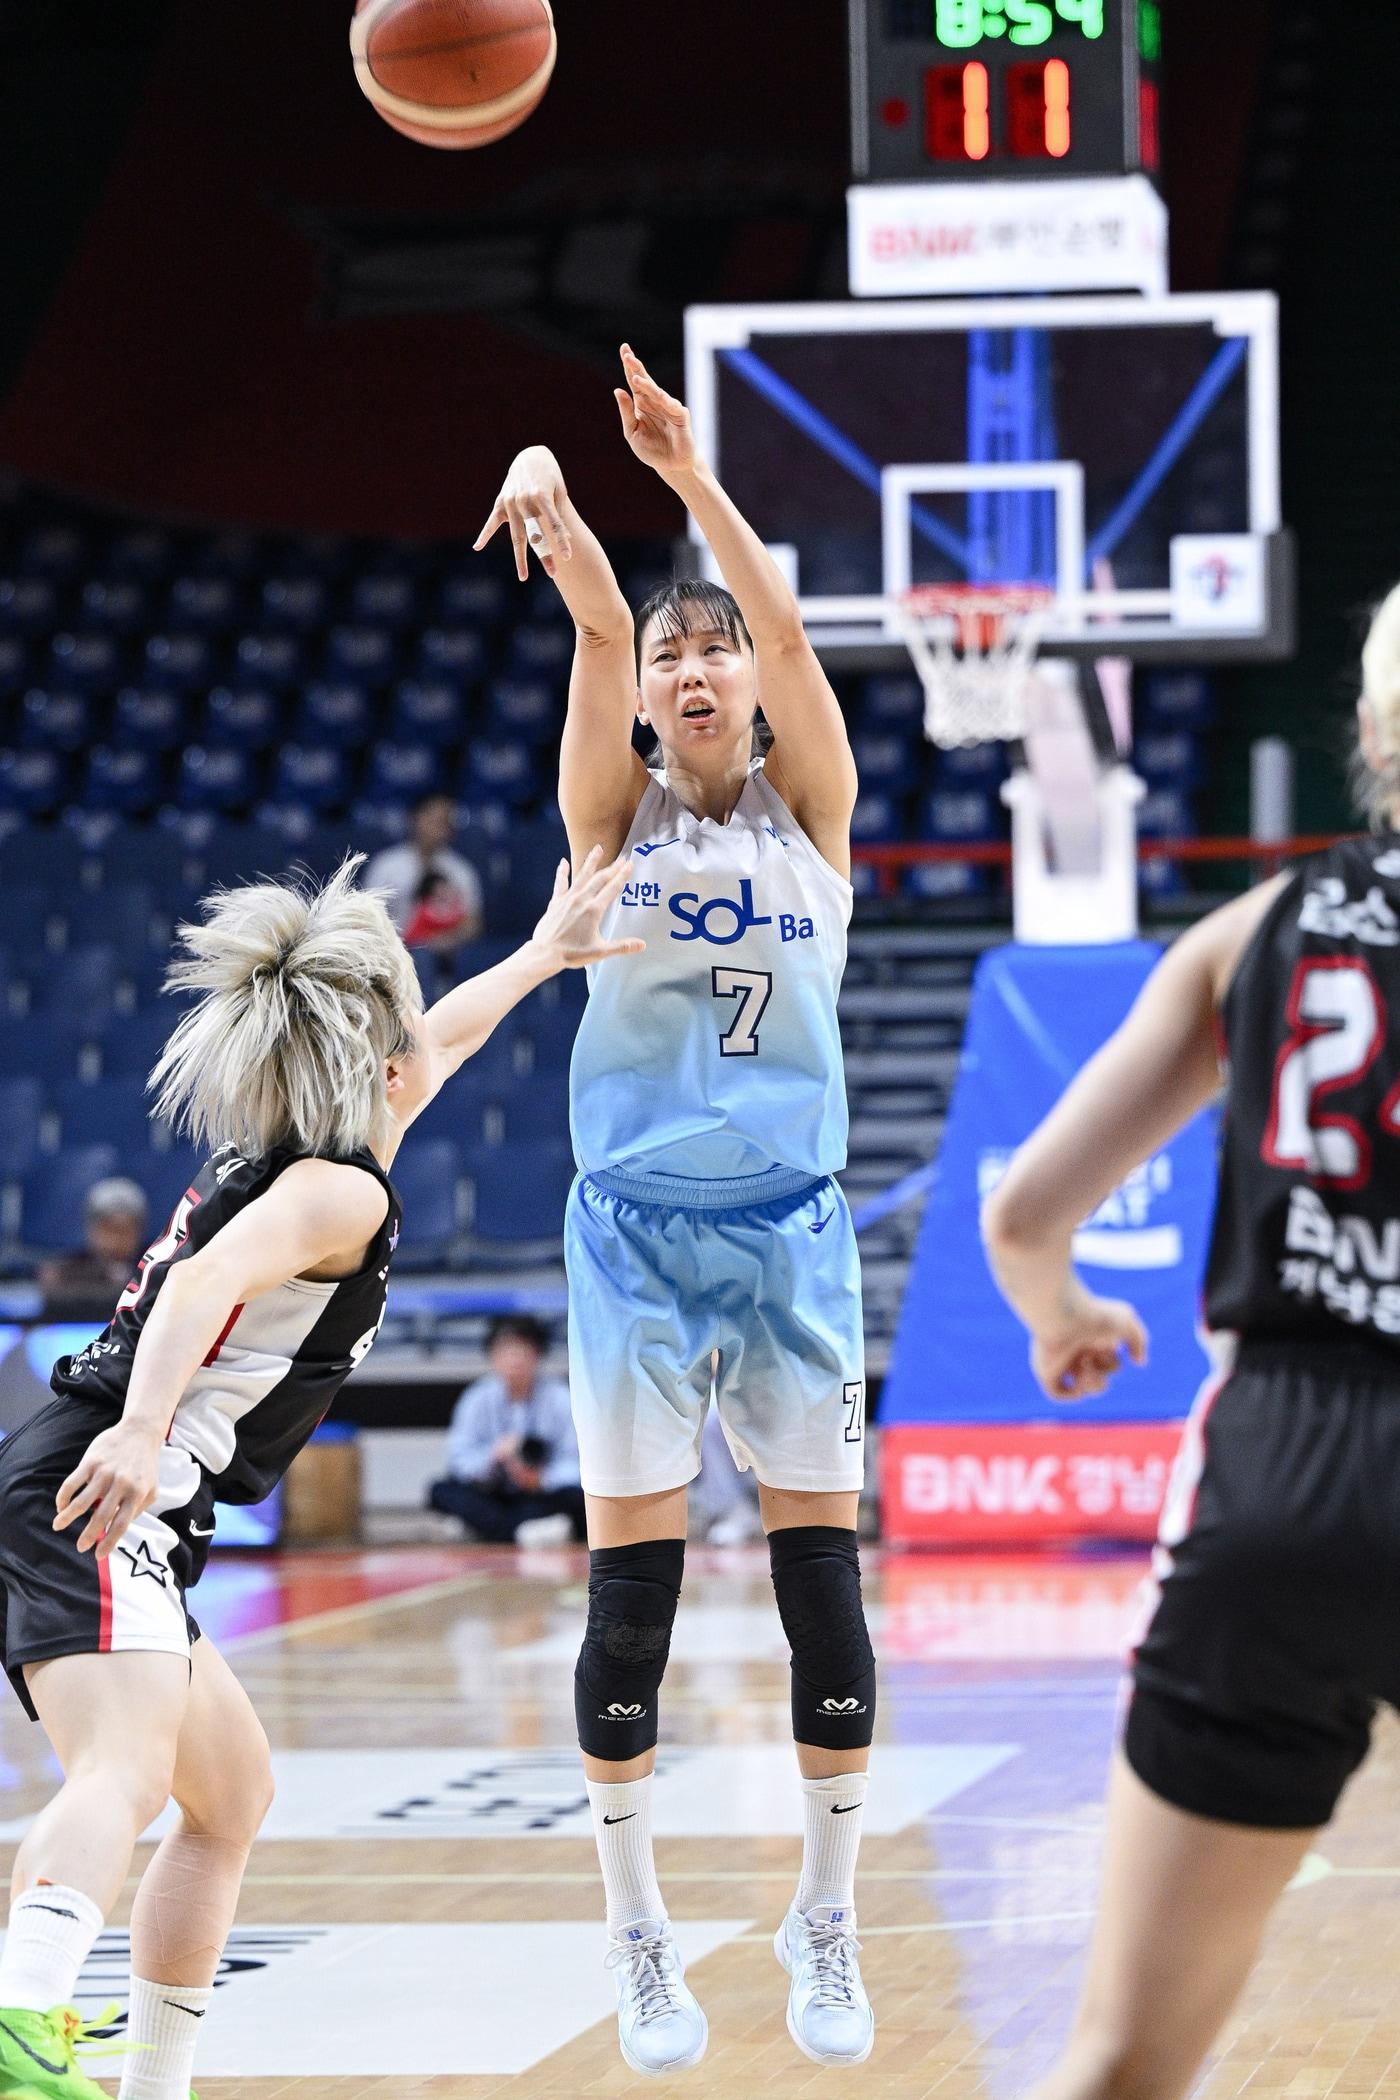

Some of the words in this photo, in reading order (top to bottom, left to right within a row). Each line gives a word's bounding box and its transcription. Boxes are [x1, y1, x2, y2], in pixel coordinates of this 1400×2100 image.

[963, 58, 1070, 160] 11
[621, 882, 662, 907] 신한
[668, 879, 772, 945] SOL
[779, 913, 820, 943] Ba
[712, 966, 773, 1057] 7
[1263, 955, 1400, 1190] 2
[843, 1381, 863, 1443] 7
[901, 1455, 1061, 1514] BNK
